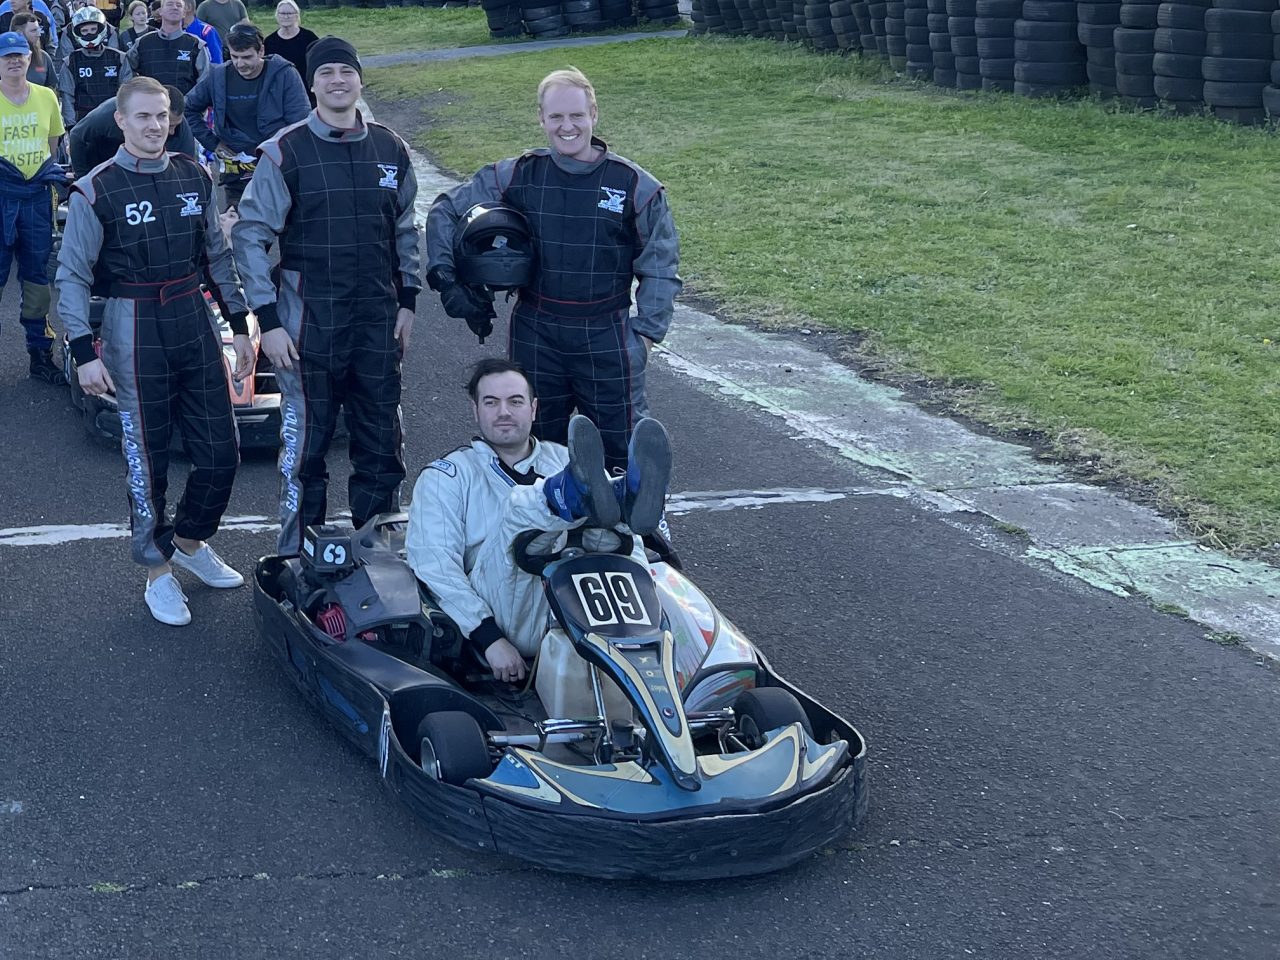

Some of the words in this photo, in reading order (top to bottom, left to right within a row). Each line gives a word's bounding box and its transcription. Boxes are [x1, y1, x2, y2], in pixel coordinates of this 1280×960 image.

[79, 67, 93, 78] 50
[1, 112, 38, 128] MOVE
[4, 124, 39, 141] FAST
[2, 138, 42, 155] THINK
[125, 200, 156, 225] 52
[285, 481, 299, 513] ARTS
[323, 543, 346, 565] 69
[578, 574, 644, 622] 69
